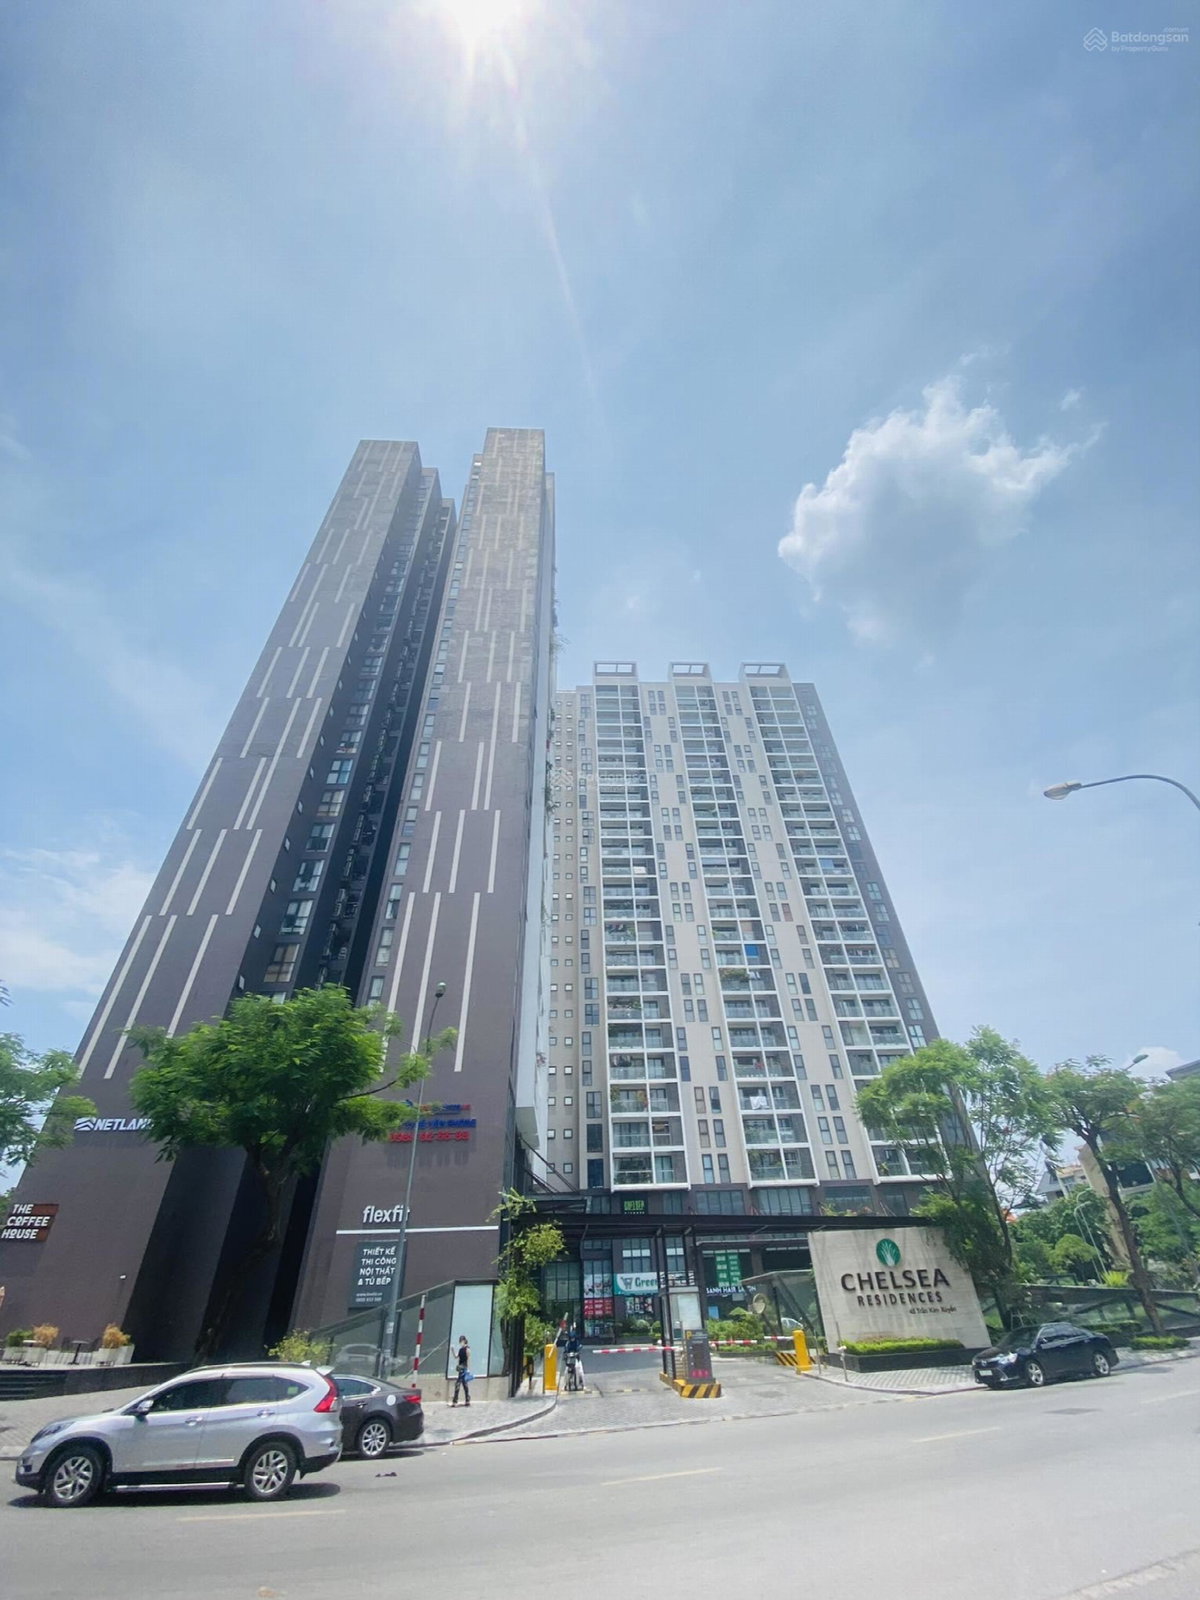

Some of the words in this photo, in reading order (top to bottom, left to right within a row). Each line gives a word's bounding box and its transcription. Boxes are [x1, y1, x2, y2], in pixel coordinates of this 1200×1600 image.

[93, 1118, 154, 1131] NETLAN
[12, 1204, 34, 1214] THE
[7, 1216, 50, 1227] COFFEE
[1, 1229, 39, 1239] HOUSE
[385, 1246, 396, 1255] KẾ
[375, 1257, 397, 1265] CÔNG
[365, 1276, 375, 1285] TỦ
[841, 1268, 950, 1291] CHELSEA
[857, 1291, 943, 1307] RESIDENCES
